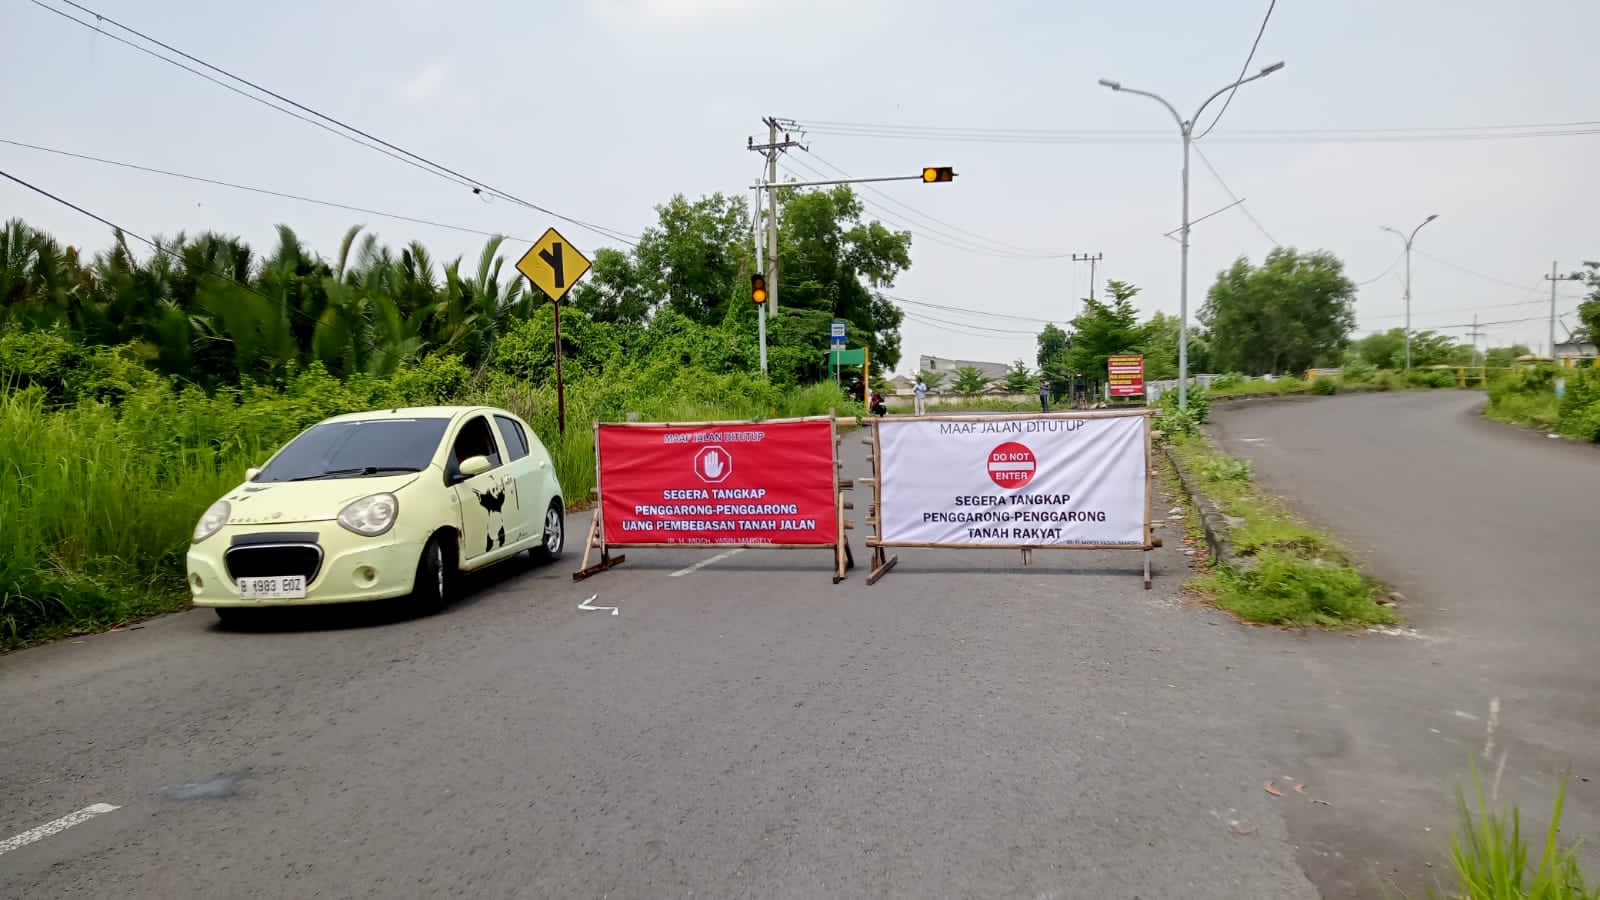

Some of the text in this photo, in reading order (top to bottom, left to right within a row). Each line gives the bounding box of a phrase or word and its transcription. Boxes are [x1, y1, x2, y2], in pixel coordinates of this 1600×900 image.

[940, 420, 1084, 434] MAAF JALAN DITUTUP
[664, 431, 765, 443] MAAF JALAN DITUTUP
[993, 452, 1030, 461] DO NOT
[995, 471, 1028, 480] ENTER
[663, 488, 766, 500] SEGERA TANGKAP
[955, 494, 1071, 506] SEGERA TANGKAP
[635, 504, 798, 515] PENGGARONG-PENGGARONG
[923, 511, 1106, 523] PENGGARONG-PENGGARONG
[622, 519, 816, 531] UANG PEMBEBASAN TANAH JALAN
[968, 527, 1063, 539] TANAH RAKYAT
[240, 580, 247, 592] B
